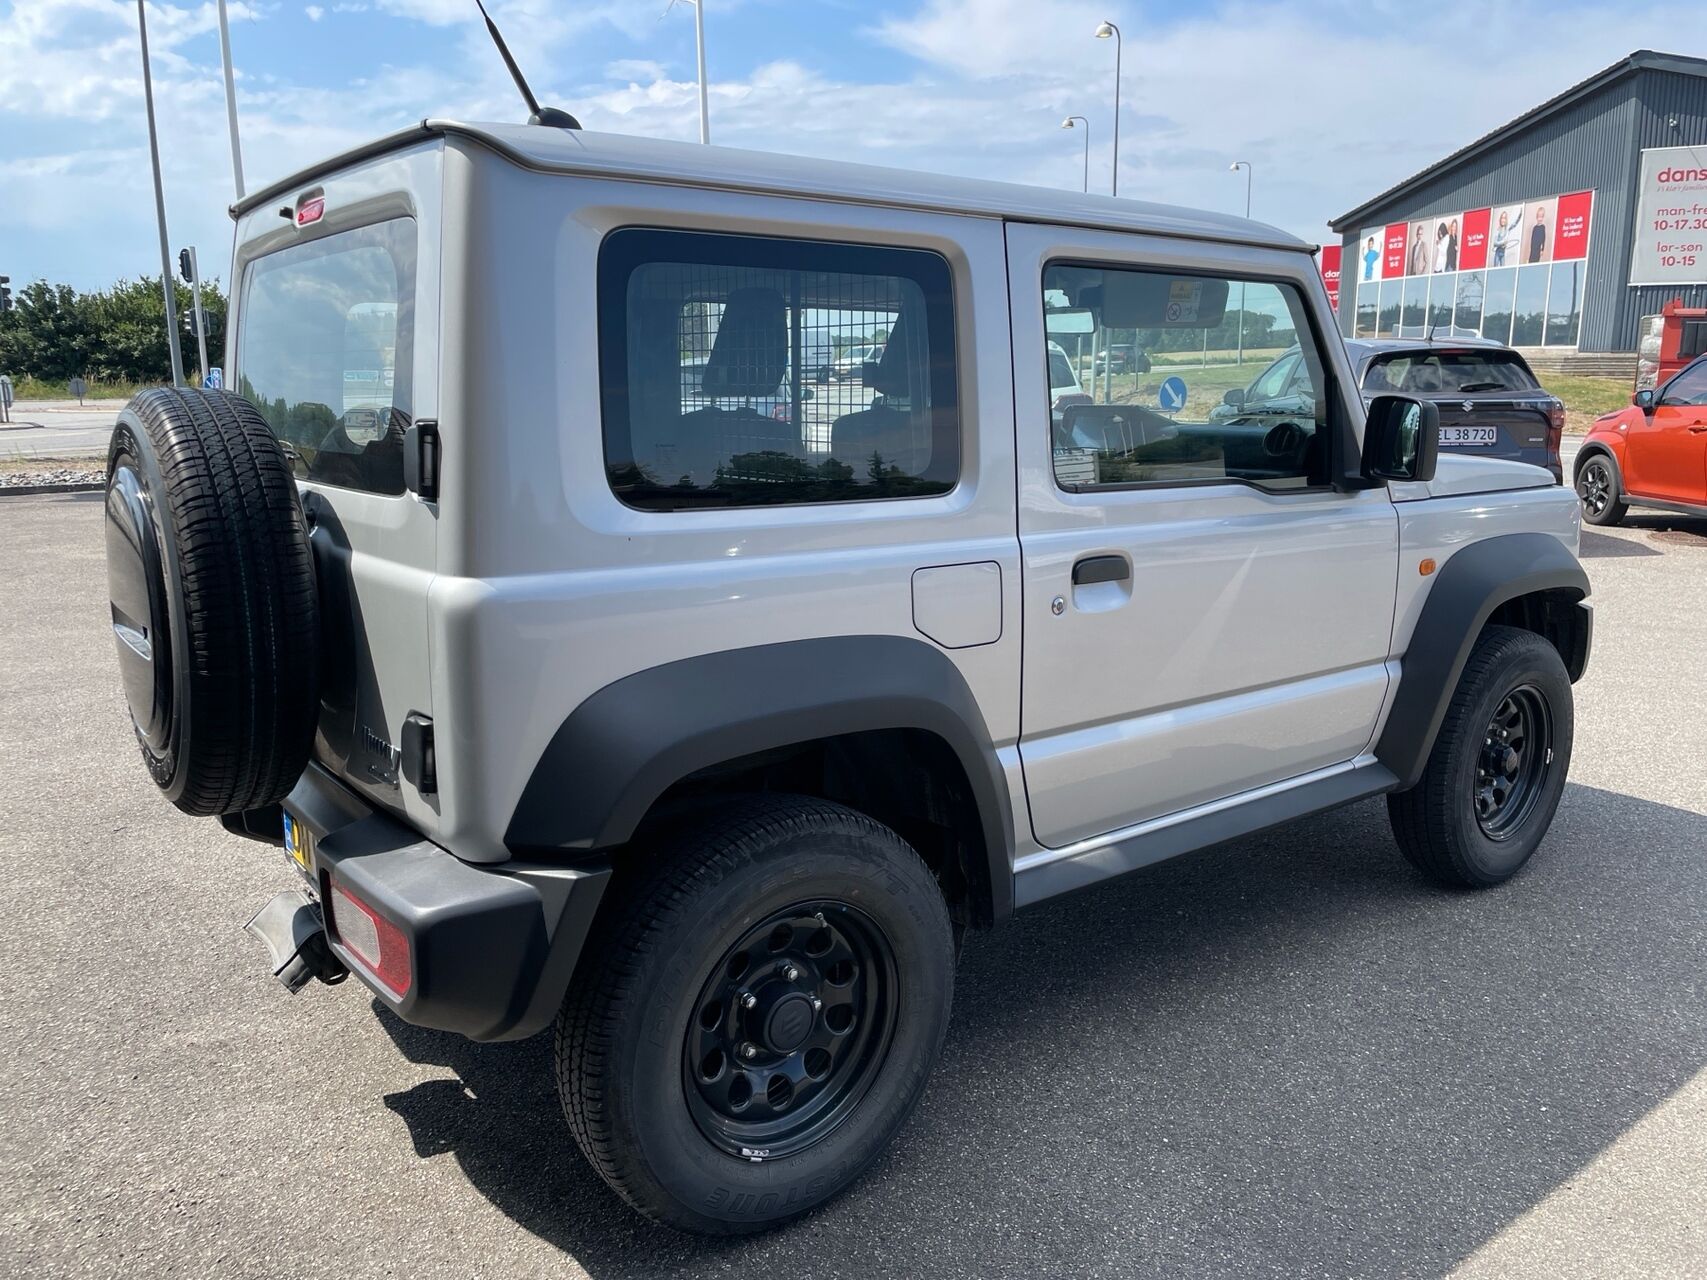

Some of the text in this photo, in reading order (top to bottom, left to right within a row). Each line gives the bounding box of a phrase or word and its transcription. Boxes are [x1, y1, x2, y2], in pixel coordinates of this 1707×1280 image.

[1657, 242, 1703, 252] lør-søn
[1661, 255, 1696, 266] 10-15
[1455, 429, 1469, 440] 38
[1473, 429, 1495, 440] 720
